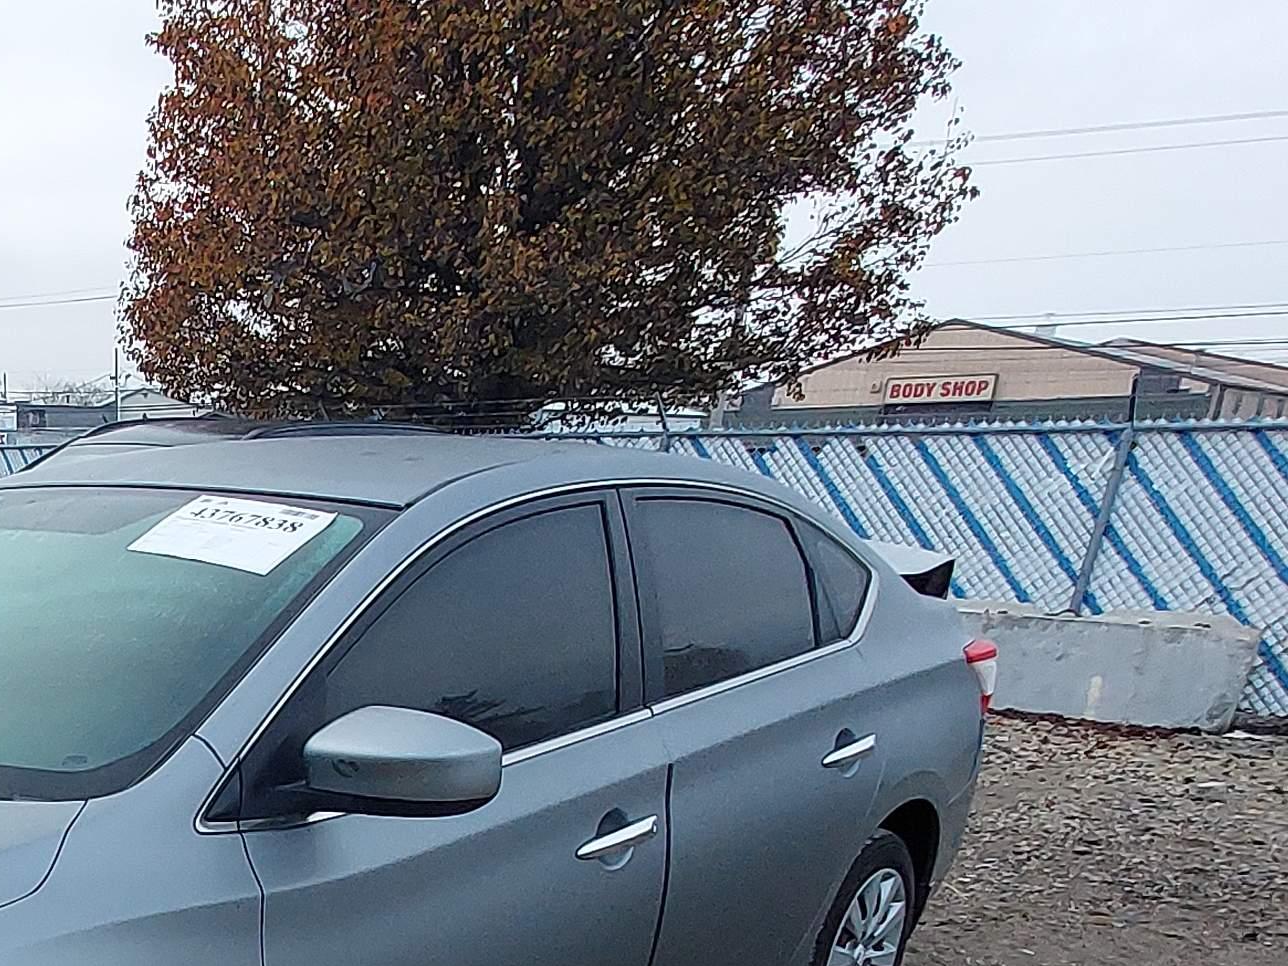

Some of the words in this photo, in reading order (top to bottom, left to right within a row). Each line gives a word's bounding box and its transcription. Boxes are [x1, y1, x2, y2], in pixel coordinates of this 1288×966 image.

[889, 383, 937, 399] BODY
[938, 380, 989, 397] SHOP
[190, 507, 304, 533] 43767838
